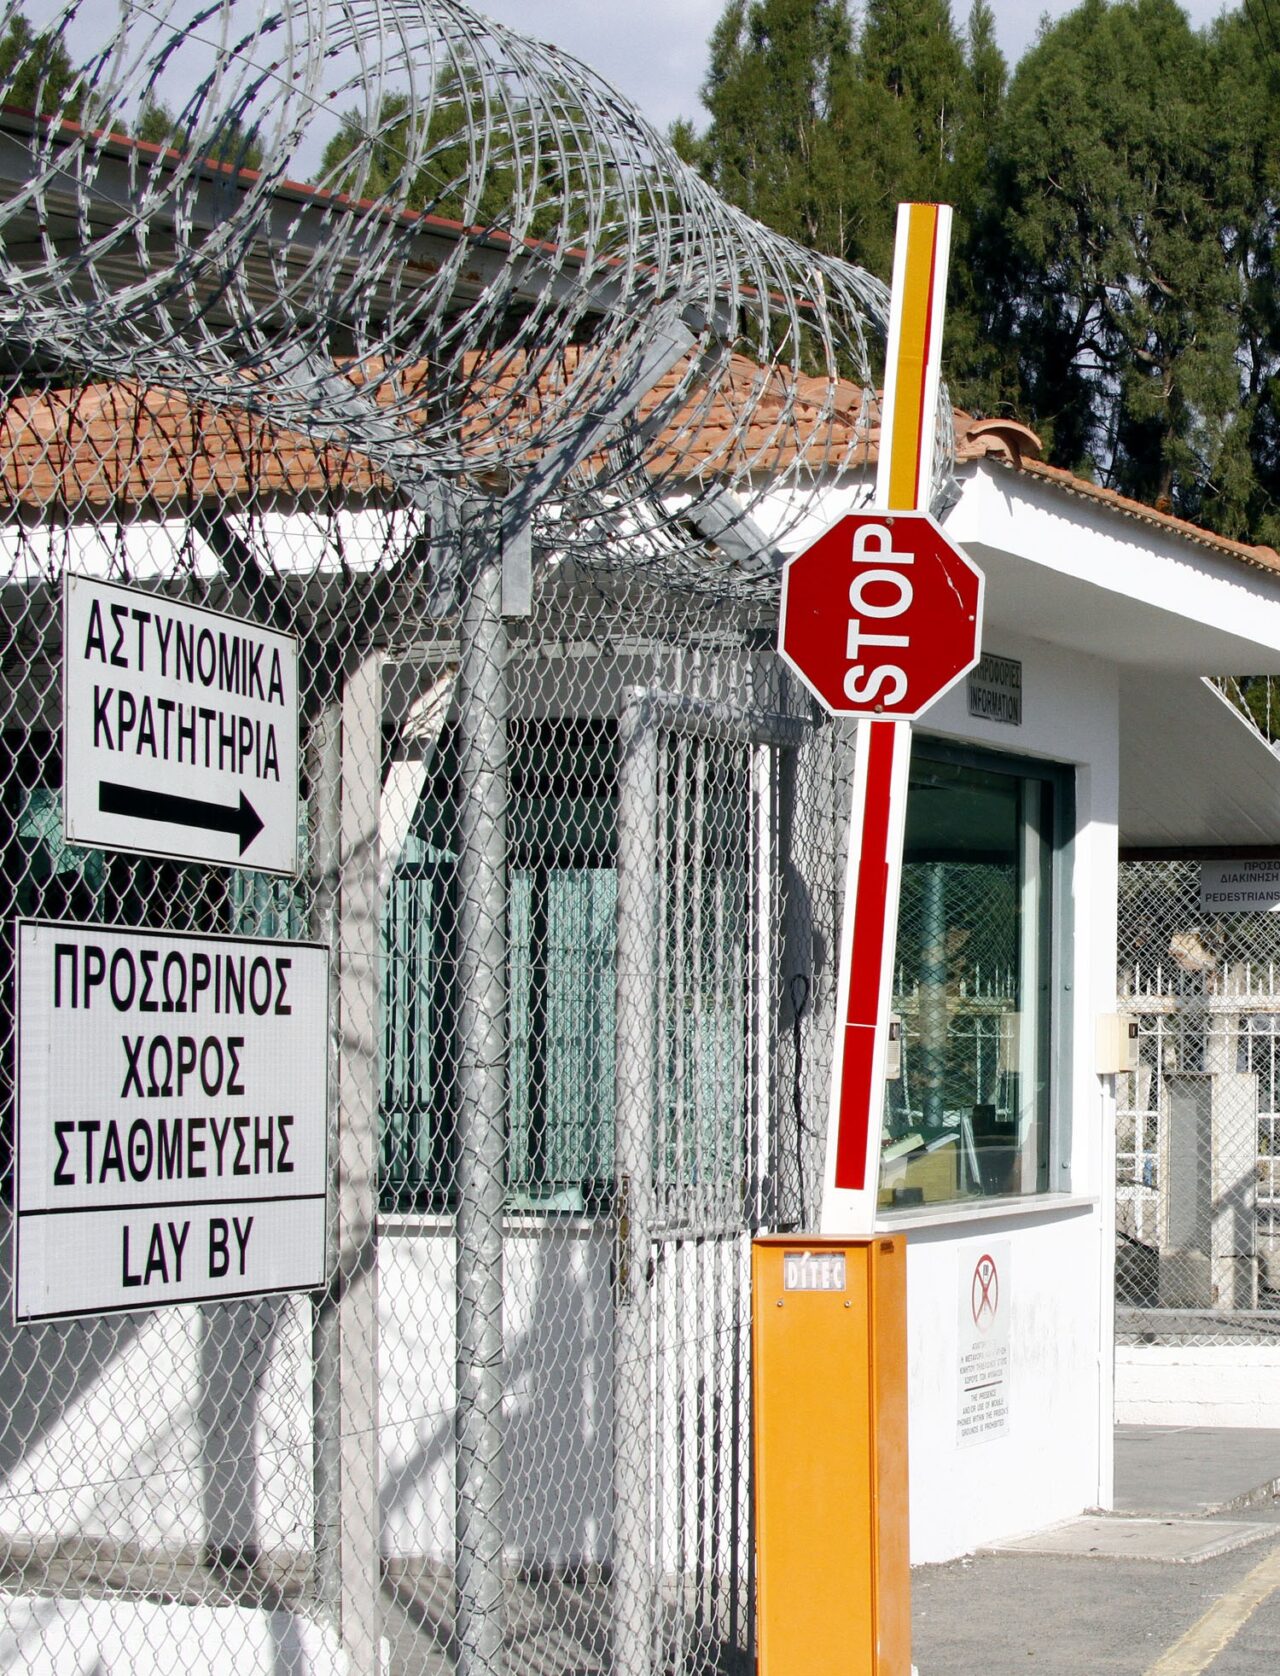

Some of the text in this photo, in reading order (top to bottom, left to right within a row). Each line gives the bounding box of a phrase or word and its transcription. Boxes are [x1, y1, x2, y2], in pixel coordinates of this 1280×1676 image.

[843, 523, 915, 706] STOP
[84, 598, 285, 706] ΑΣΤΥΝΟΜΙΚΑ
[94, 685, 280, 782] ΚΡΑΤΗΤΗΡΙΑ
[970, 685, 1018, 721] INFORMATION
[1205, 891, 1280, 902] PEDESTRIANS
[1220, 872, 1279, 884] ΔΙΑΚΙΝΗΣΗ
[54, 943, 293, 1016] ΠΡΟΣΩΡΙΝΟΣ
[121, 1034, 245, 1098] ΧΩΡΟΣ
[54, 1115, 294, 1186] ΣΤΑΘΜΕΥΣΗΣ
[122, 1216, 254, 1287] LAY BY
